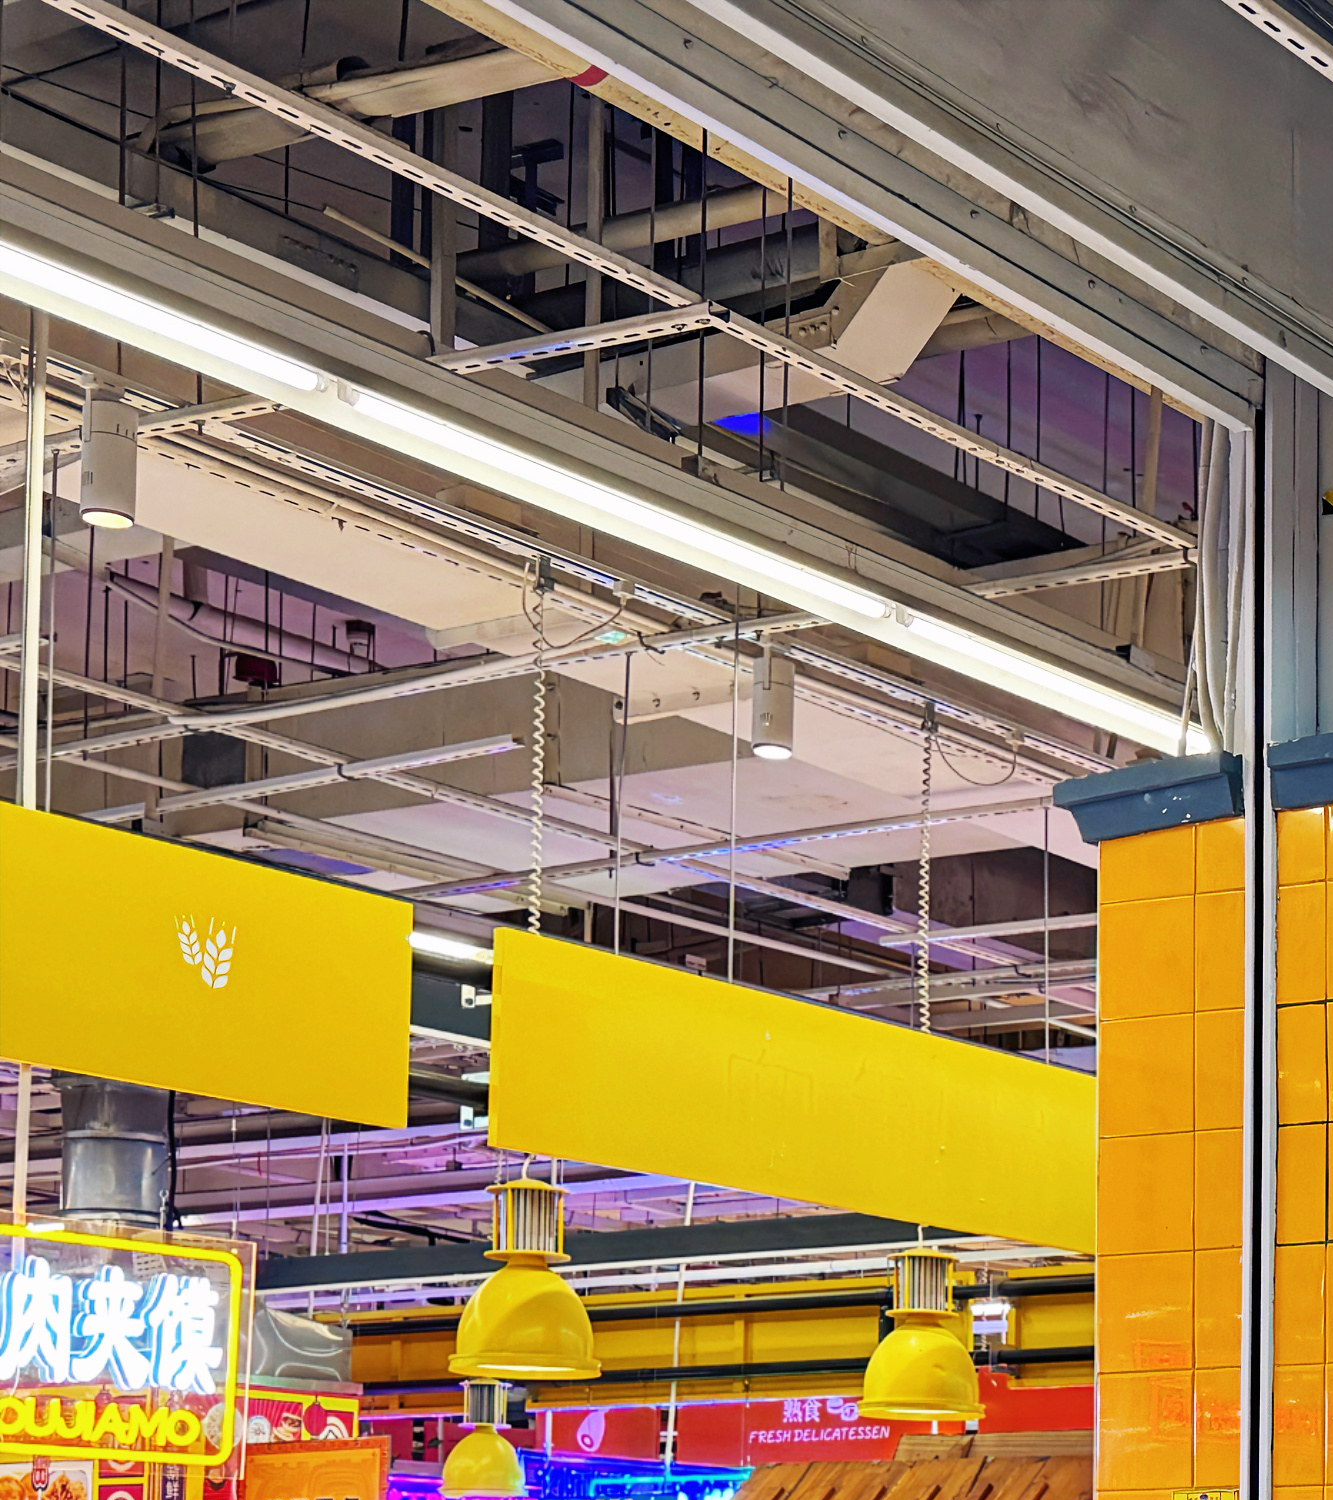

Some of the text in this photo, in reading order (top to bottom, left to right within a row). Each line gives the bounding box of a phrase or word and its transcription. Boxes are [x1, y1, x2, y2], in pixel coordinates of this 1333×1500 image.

[783, 1398, 820, 1424] 熟食
[749, 1425, 890, 1444] FRESH DELICATESSEN
